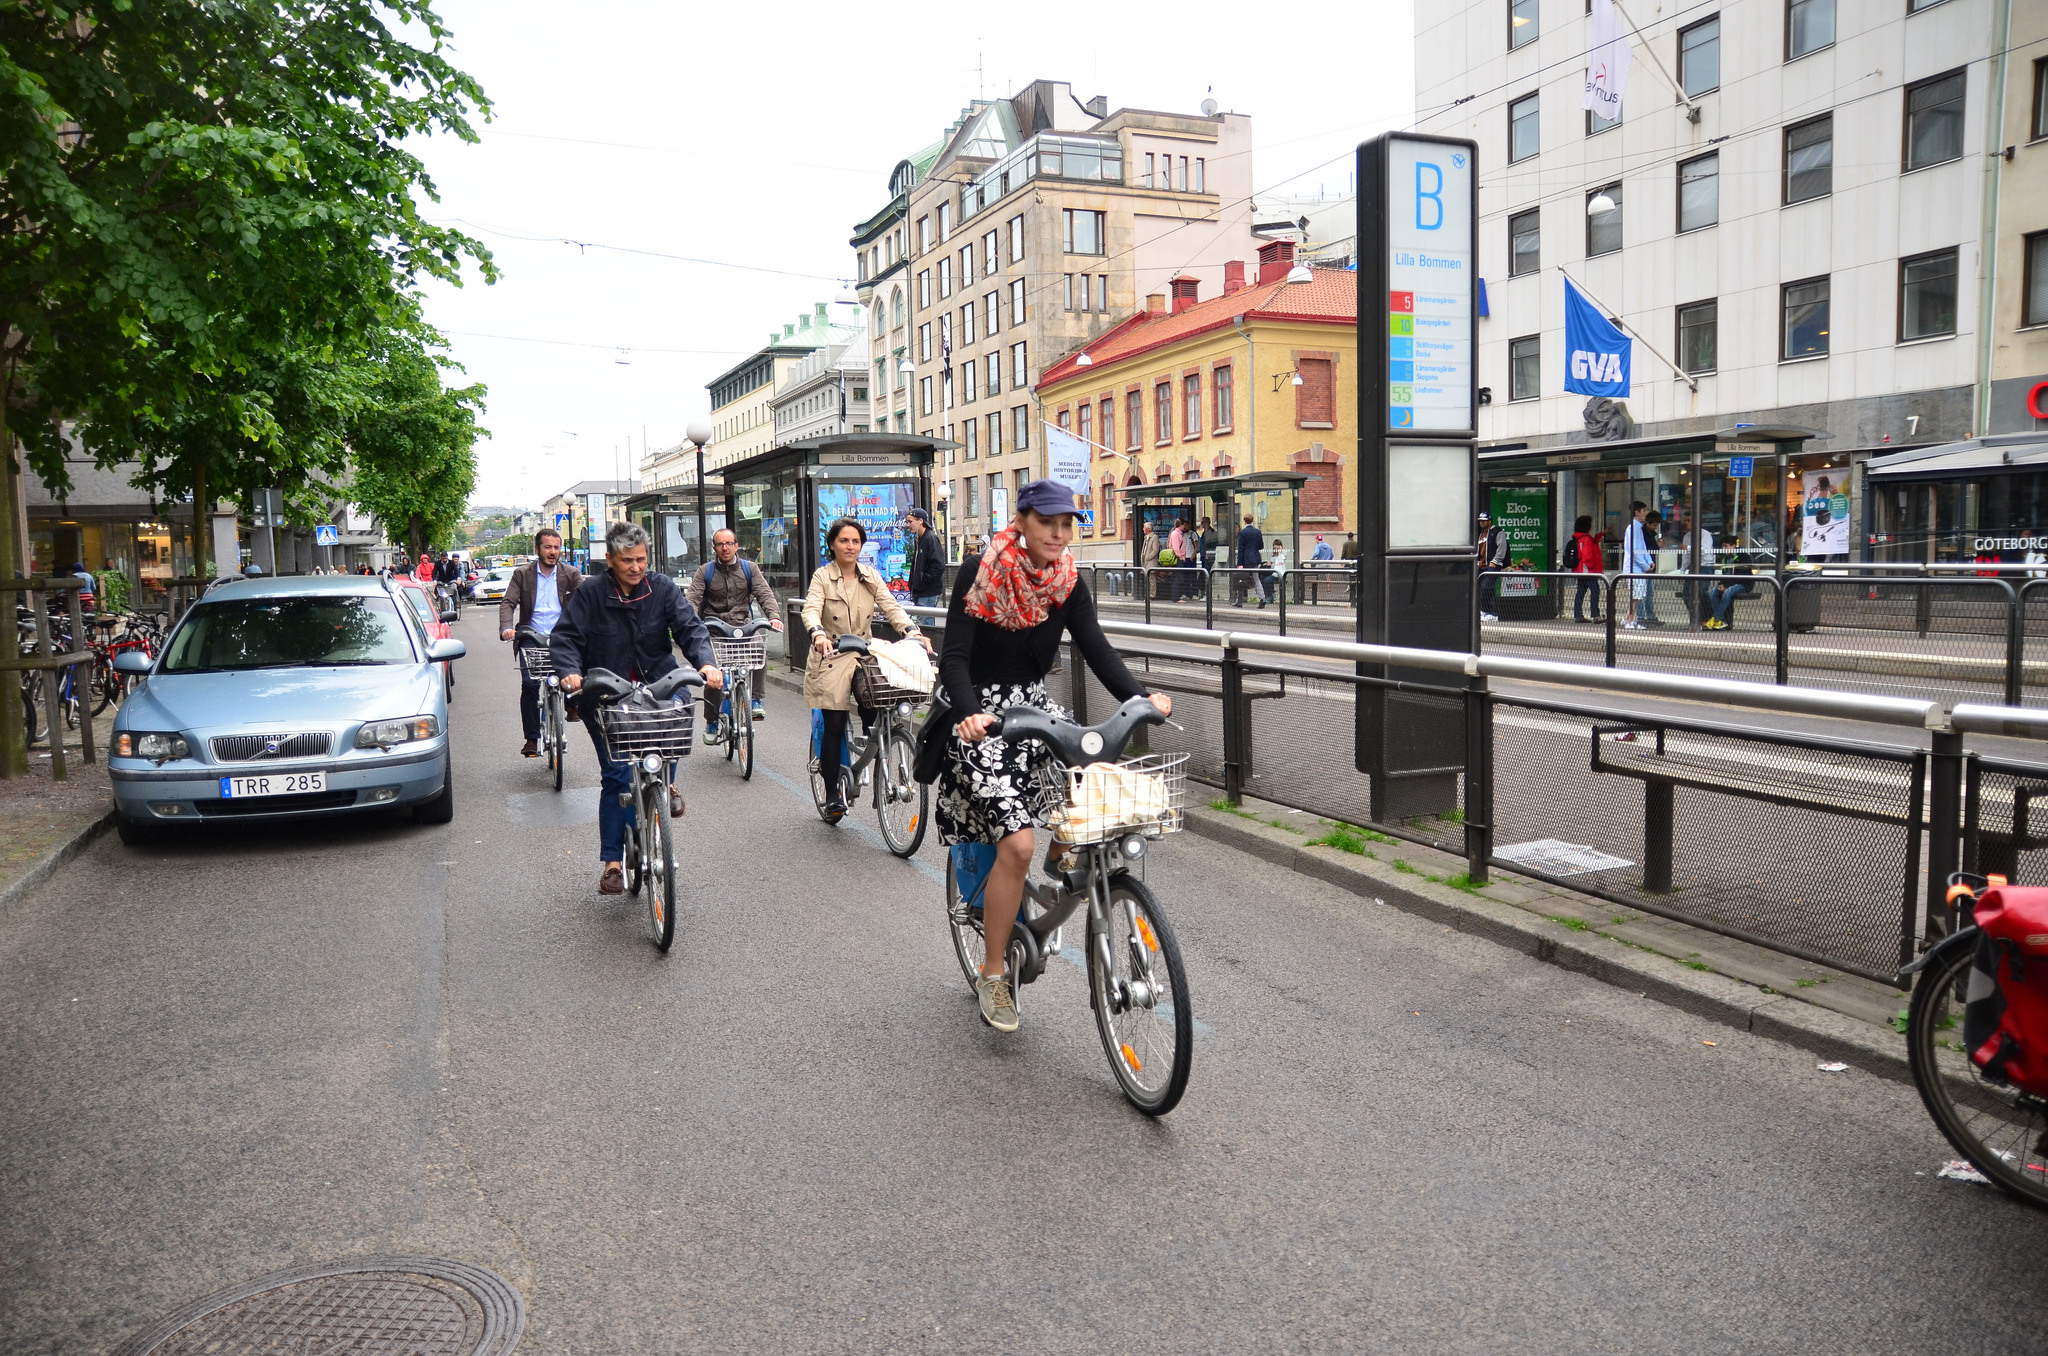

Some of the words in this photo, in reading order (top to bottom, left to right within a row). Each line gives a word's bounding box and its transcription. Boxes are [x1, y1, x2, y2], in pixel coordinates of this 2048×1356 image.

[1585, 81, 1619, 104] avntus
[1415, 162, 1444, 231] B
[1395, 252, 1415, 267] Lilla
[1419, 254, 1462, 270] Bommen
[1404, 295, 1411, 310] 5
[1401, 319, 1411, 333] 10
[1571, 349, 1624, 383] GVA
[1392, 385, 1412, 403] 55
[1906, 415, 1920, 436] 7
[1728, 443, 1736, 451] Lilla
[841, 454, 855, 463] Lilla
[857, 455, 890, 463] Bommen
[593, 496, 600, 509] B
[996, 491, 1004, 503] A
[832, 506, 845, 517] DET
[846, 504, 856, 517] ÄR
[857, 506, 889, 517] SKILLNAD
[890, 505, 899, 516] PÅ
[1506, 502, 1532, 514] Eko-
[859, 519, 872, 528] OCH
[1497, 516, 1541, 527] trenden
[1514, 528, 1540, 540] över.
[1974, 536, 2048, 551] GÖTEBORG
[233, 777, 270, 795] TRR
[285, 774, 322, 792] 285
